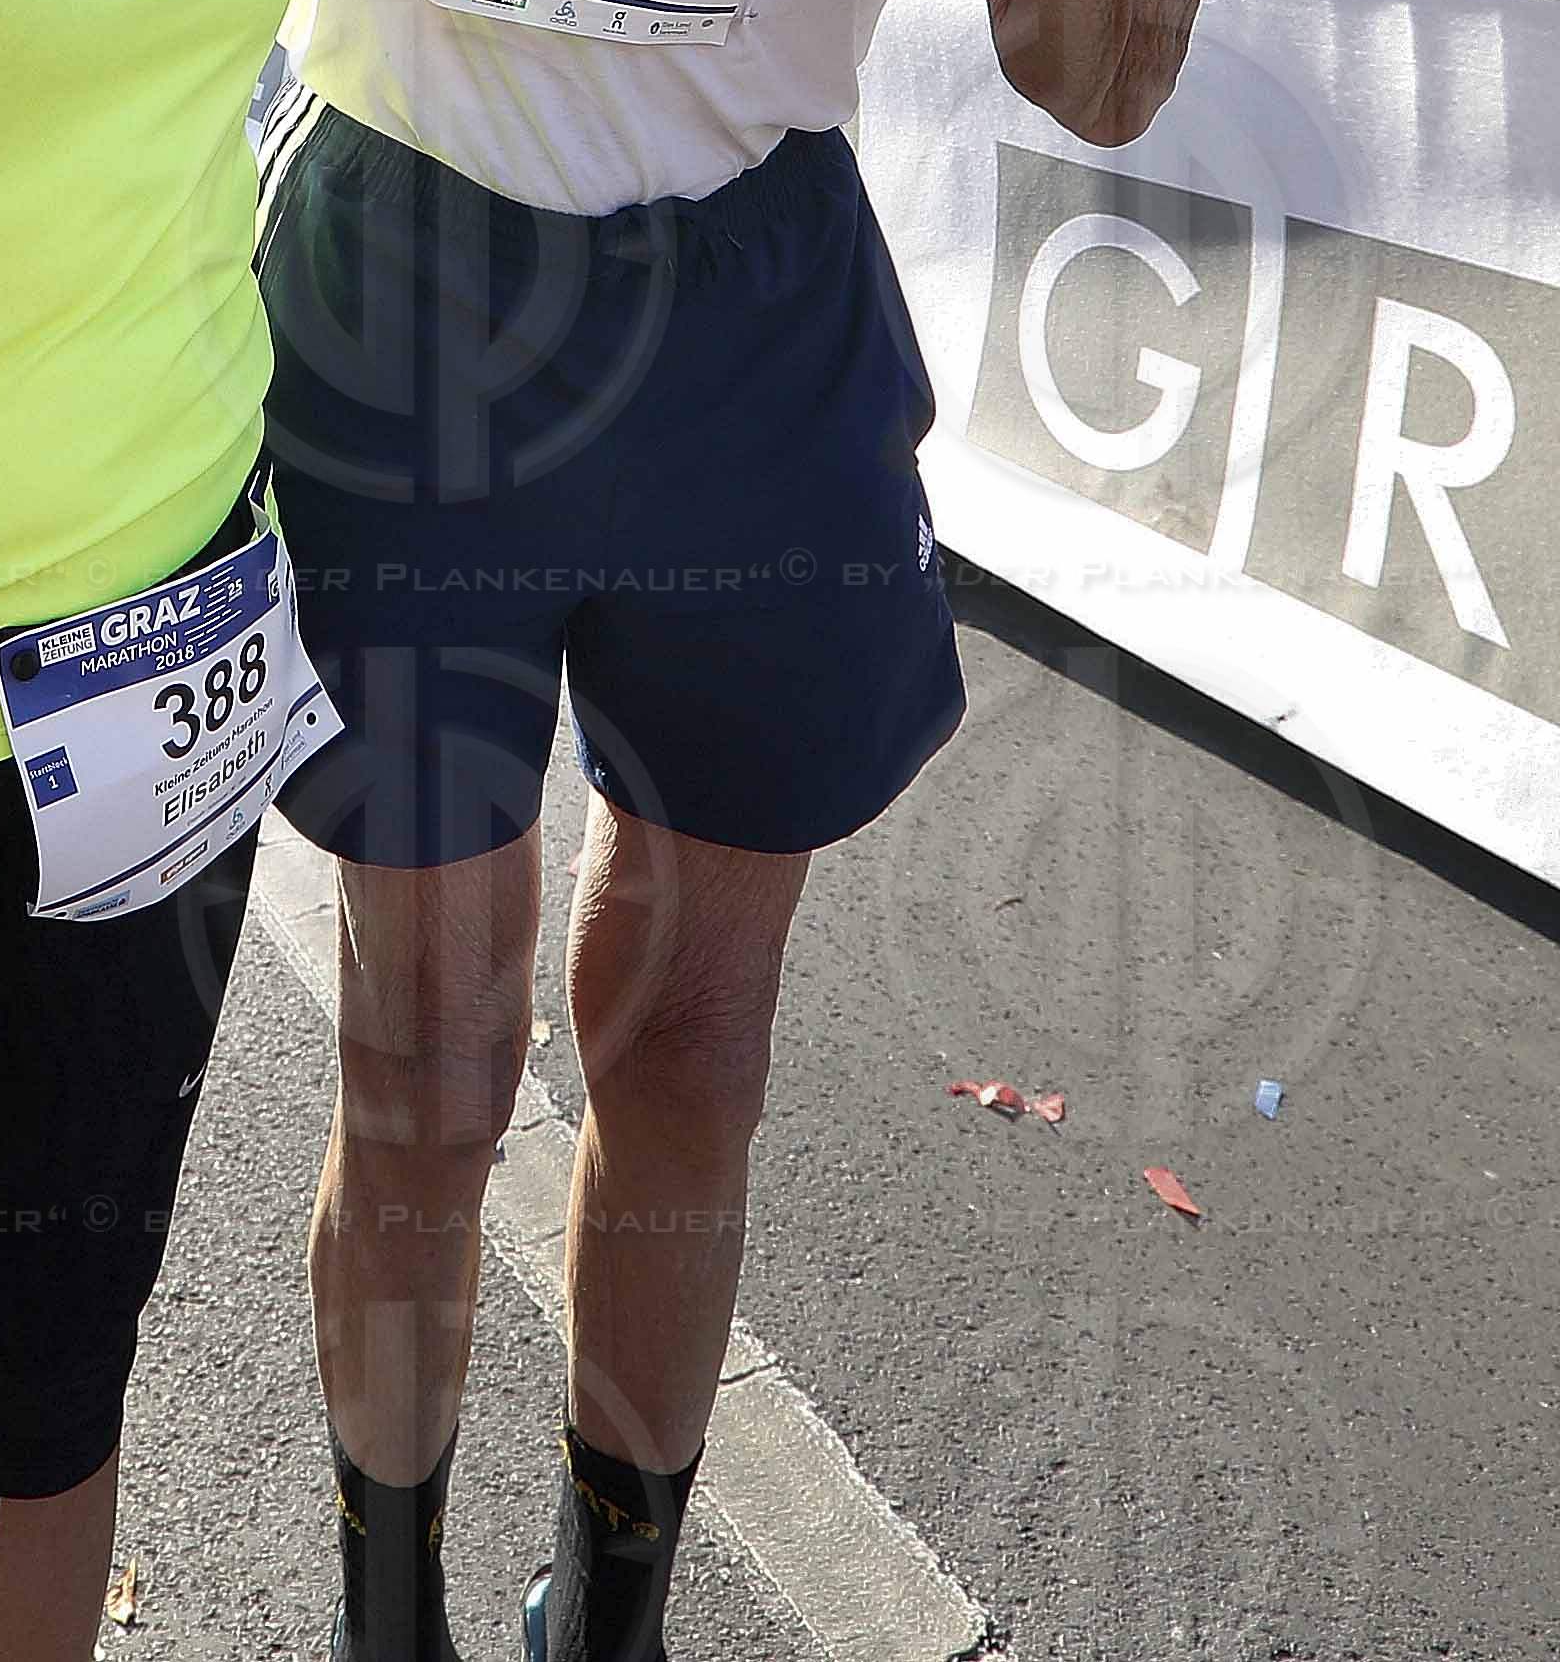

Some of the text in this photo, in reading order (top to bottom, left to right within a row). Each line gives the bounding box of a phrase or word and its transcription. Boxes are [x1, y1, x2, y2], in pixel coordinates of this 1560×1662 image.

[226, 578, 242, 597] 25
[100, 585, 201, 647] GRAZ
[42, 627, 91, 652] KLEINE
[43, 638, 93, 663] ZEITUNG
[80, 631, 178, 677] MARATHON
[155, 645, 195, 671] 2018
[153, 632, 267, 760] 388
[154, 698, 274, 797] Kleine Zeitung Marathon
[29, 757, 70, 780] Startblock
[163, 730, 266, 827] Elisabeth
[48, 775, 59, 789] 1
